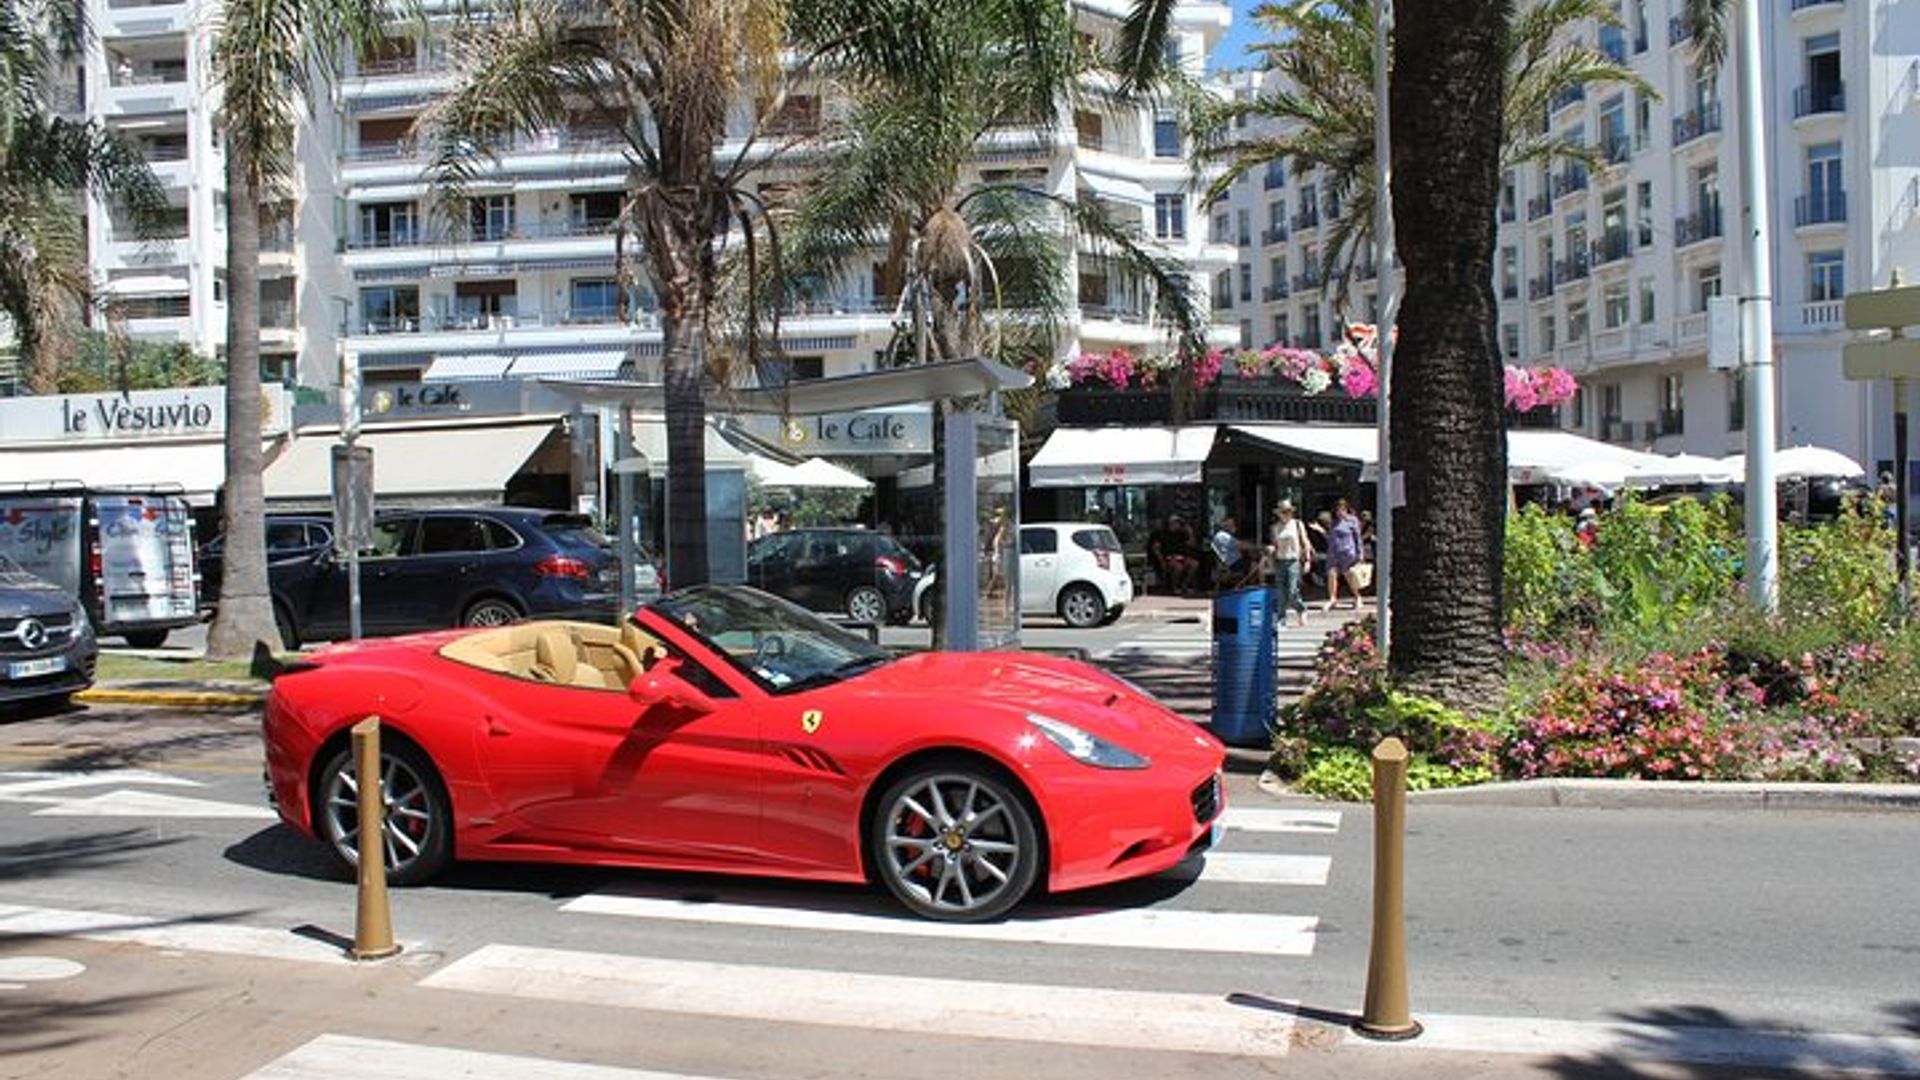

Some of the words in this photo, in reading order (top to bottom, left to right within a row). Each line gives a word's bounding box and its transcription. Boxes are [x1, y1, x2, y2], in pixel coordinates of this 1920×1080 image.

[63, 399, 87, 432] le
[817, 416, 839, 440] le
[847, 414, 905, 443] Cafe
